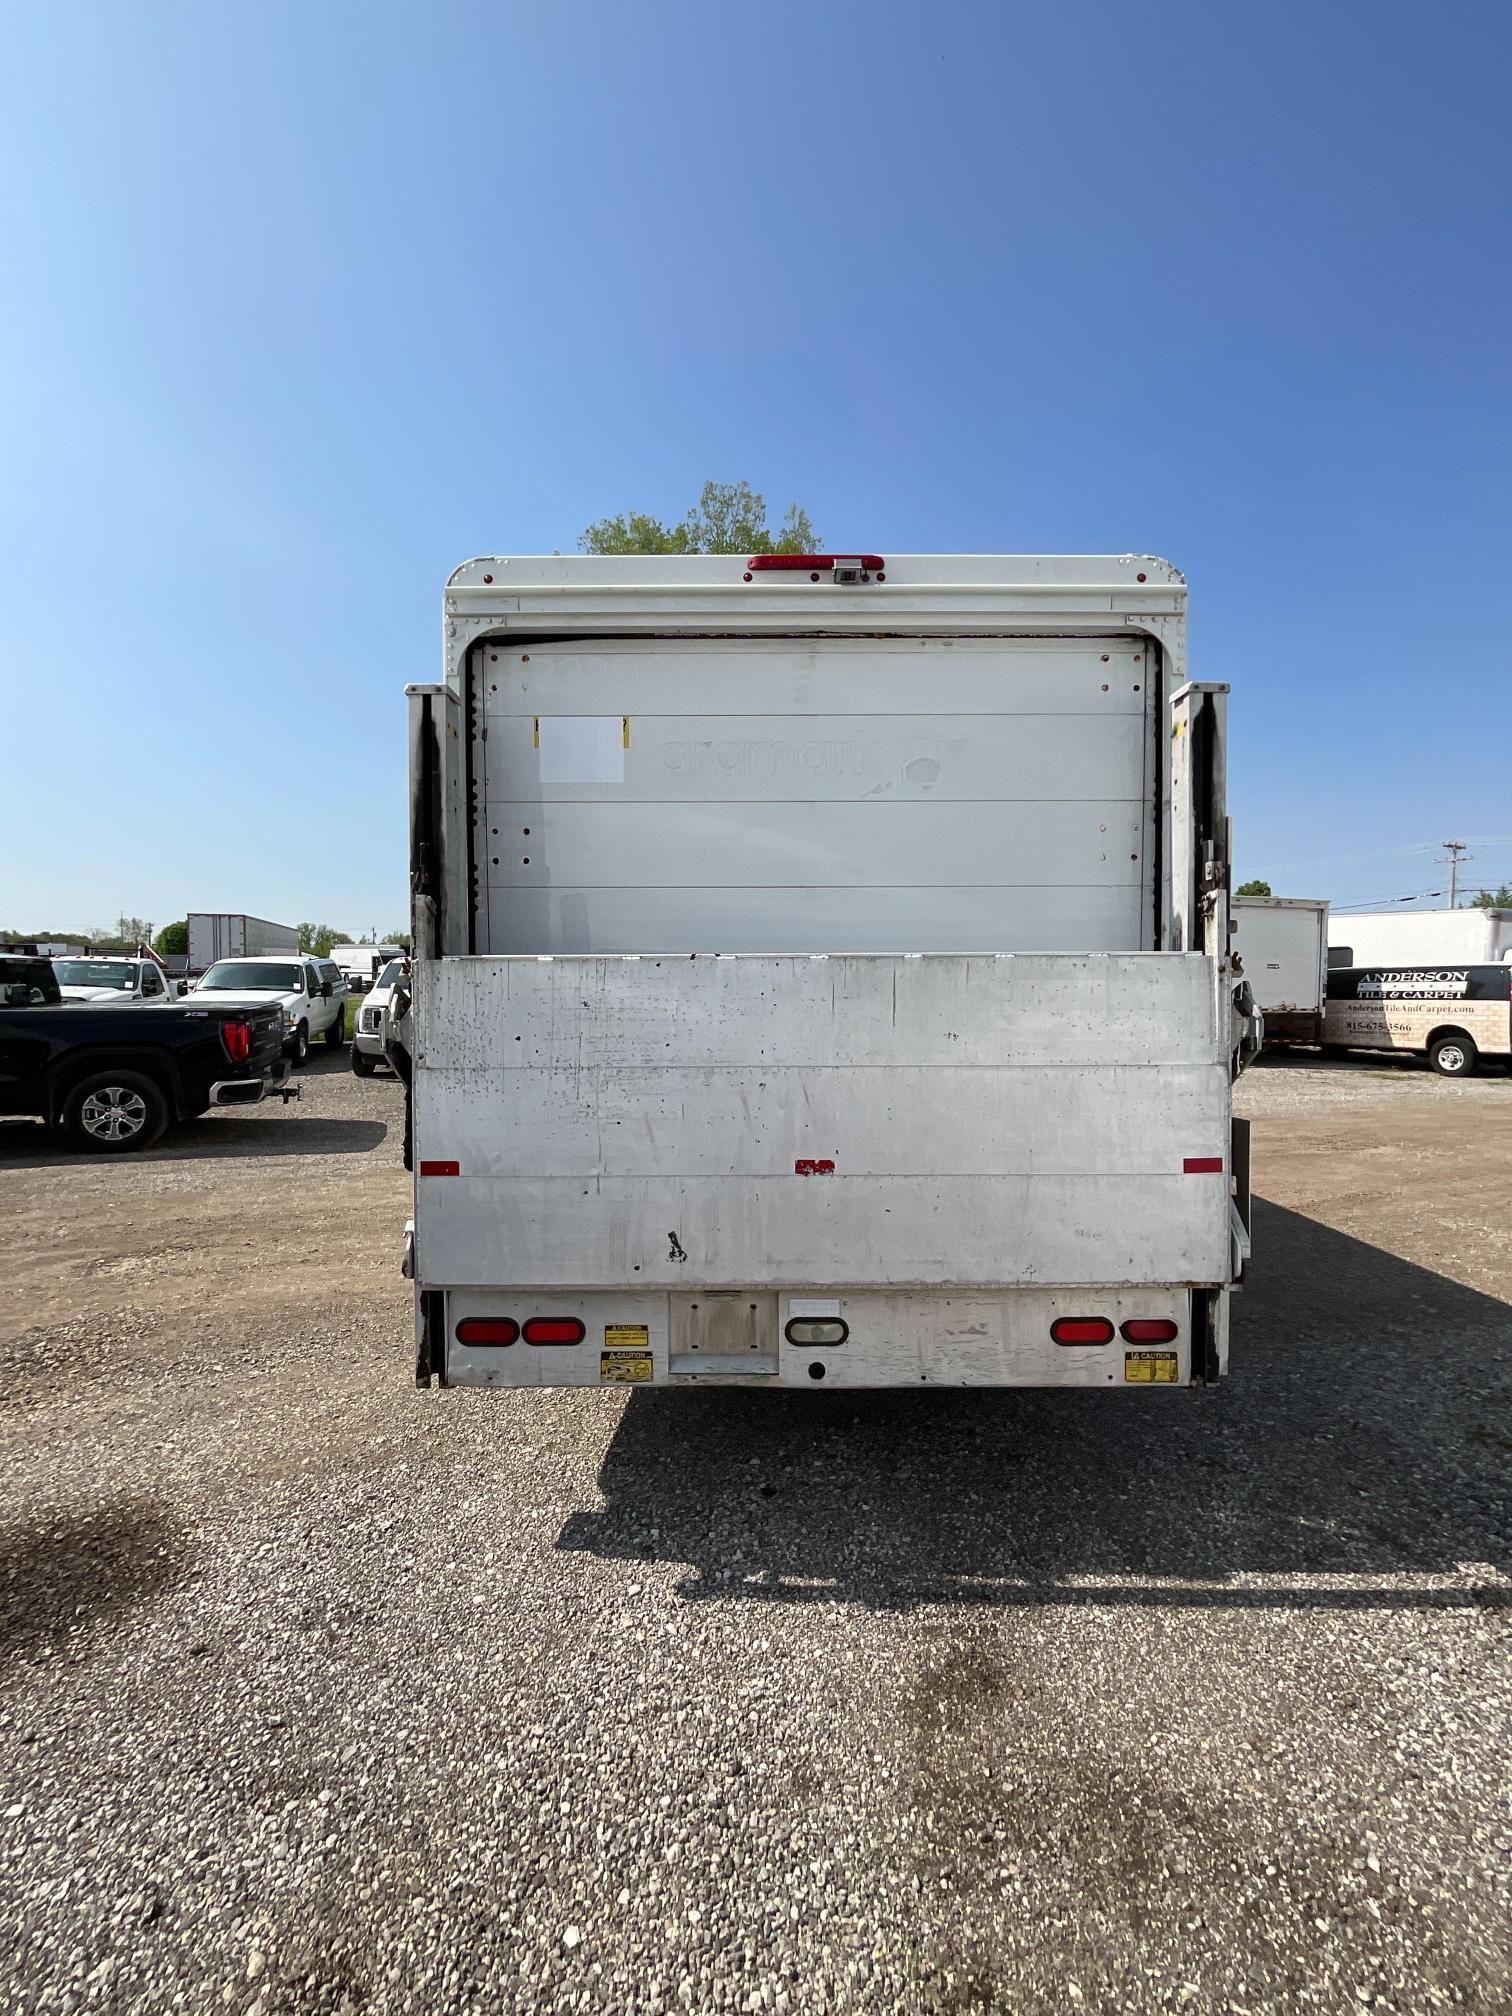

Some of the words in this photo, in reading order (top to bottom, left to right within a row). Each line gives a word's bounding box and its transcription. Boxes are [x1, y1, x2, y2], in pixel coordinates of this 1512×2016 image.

[1360, 971, 1470, 982] ANDERSON
[1358, 991, 1387, 999] TILE
[1389, 991, 1400, 999] &
[1402, 991, 1463, 999] CARPET
[1346, 1004, 1475, 1014] AndersonTileAndCarpet.com
[1346, 1021, 1412, 1032] 815-675-3566
